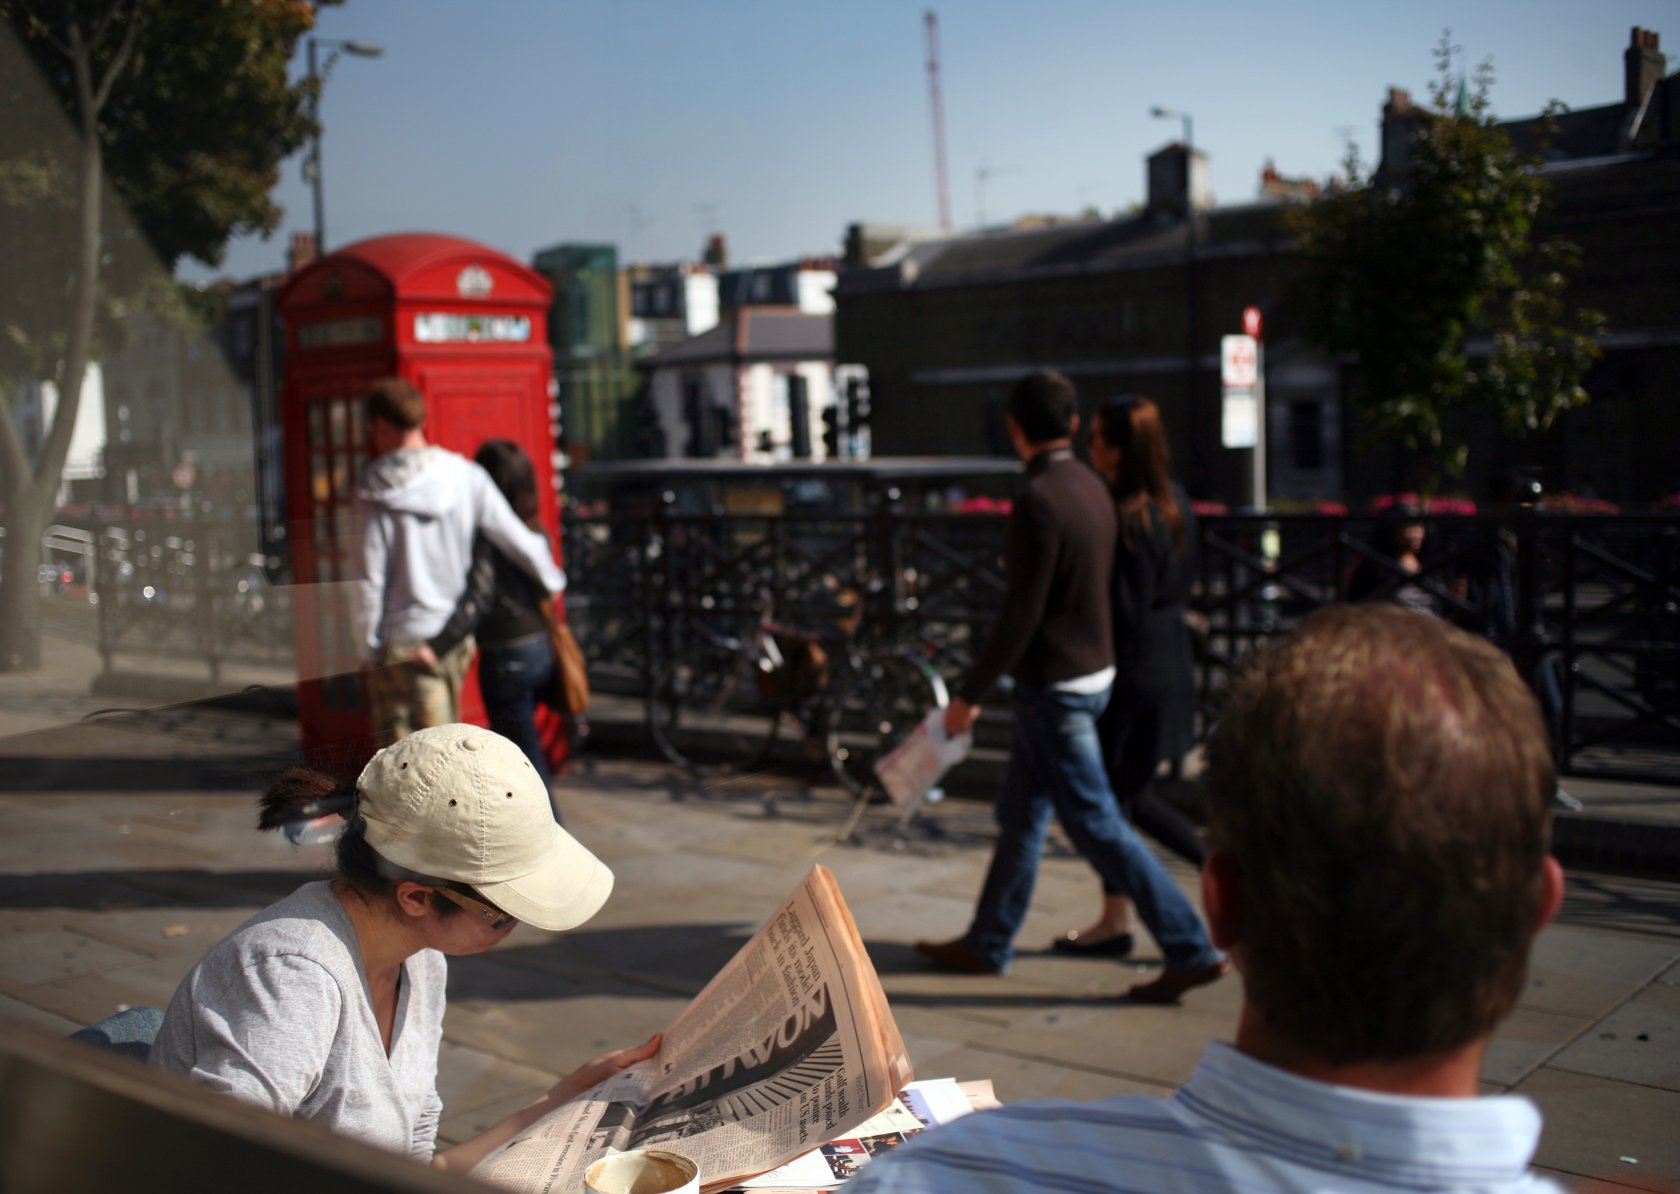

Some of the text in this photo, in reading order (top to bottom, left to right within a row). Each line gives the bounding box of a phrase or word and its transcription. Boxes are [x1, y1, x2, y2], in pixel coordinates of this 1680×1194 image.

[766, 922, 801, 1007] back in fashion
[776, 912, 814, 994] finds its model
[786, 900, 811, 947] Laggard
[804, 945, 821, 982] Japan
[800, 1092, 810, 1145] on US assets
[810, 1083, 821, 1125] to pounce
[822, 1075, 837, 1130] funds poised
[836, 1067, 850, 1119] Gulf wealth
[555, 1143, 571, 1167] recession
